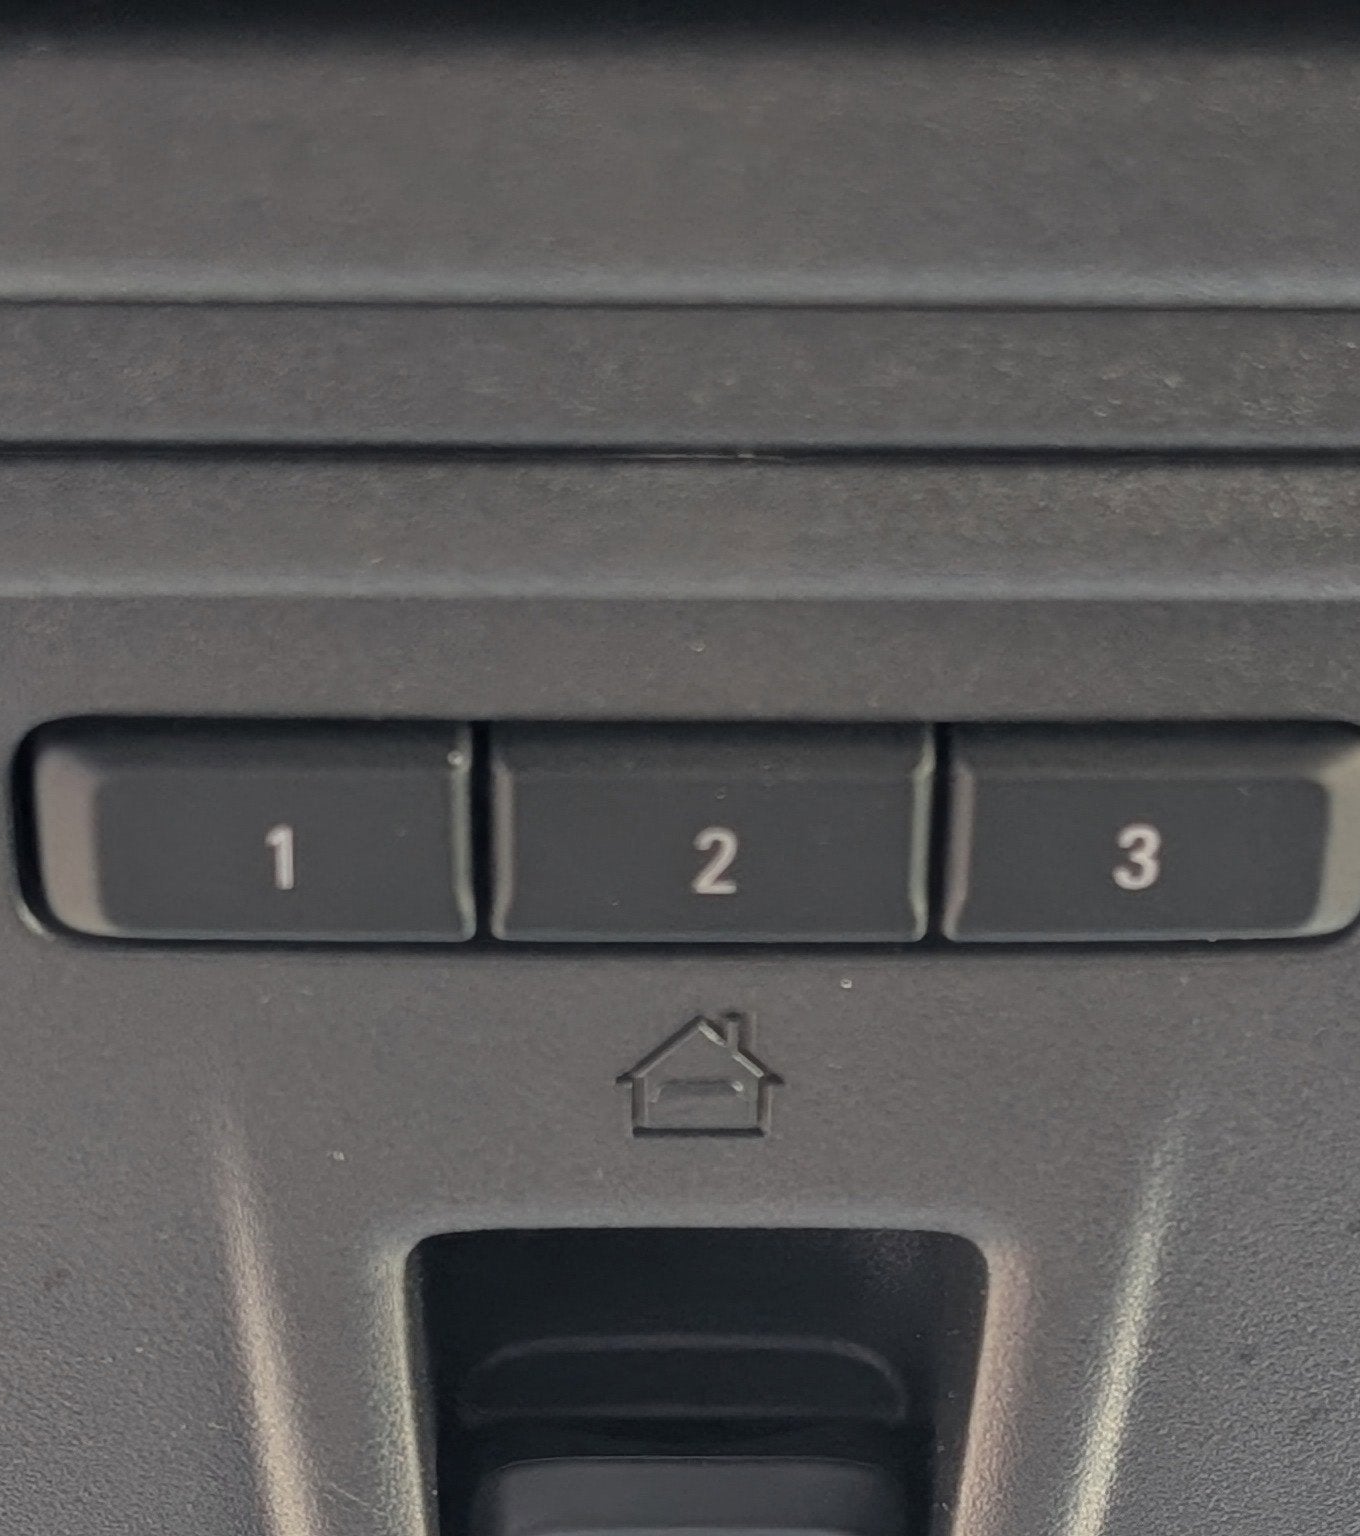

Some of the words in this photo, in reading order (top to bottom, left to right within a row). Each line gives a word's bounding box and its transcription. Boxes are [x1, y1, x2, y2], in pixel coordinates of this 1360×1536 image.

[265, 825, 295, 891] 1
[692, 830, 739, 896] 2
[1113, 824, 1162, 892] 3
